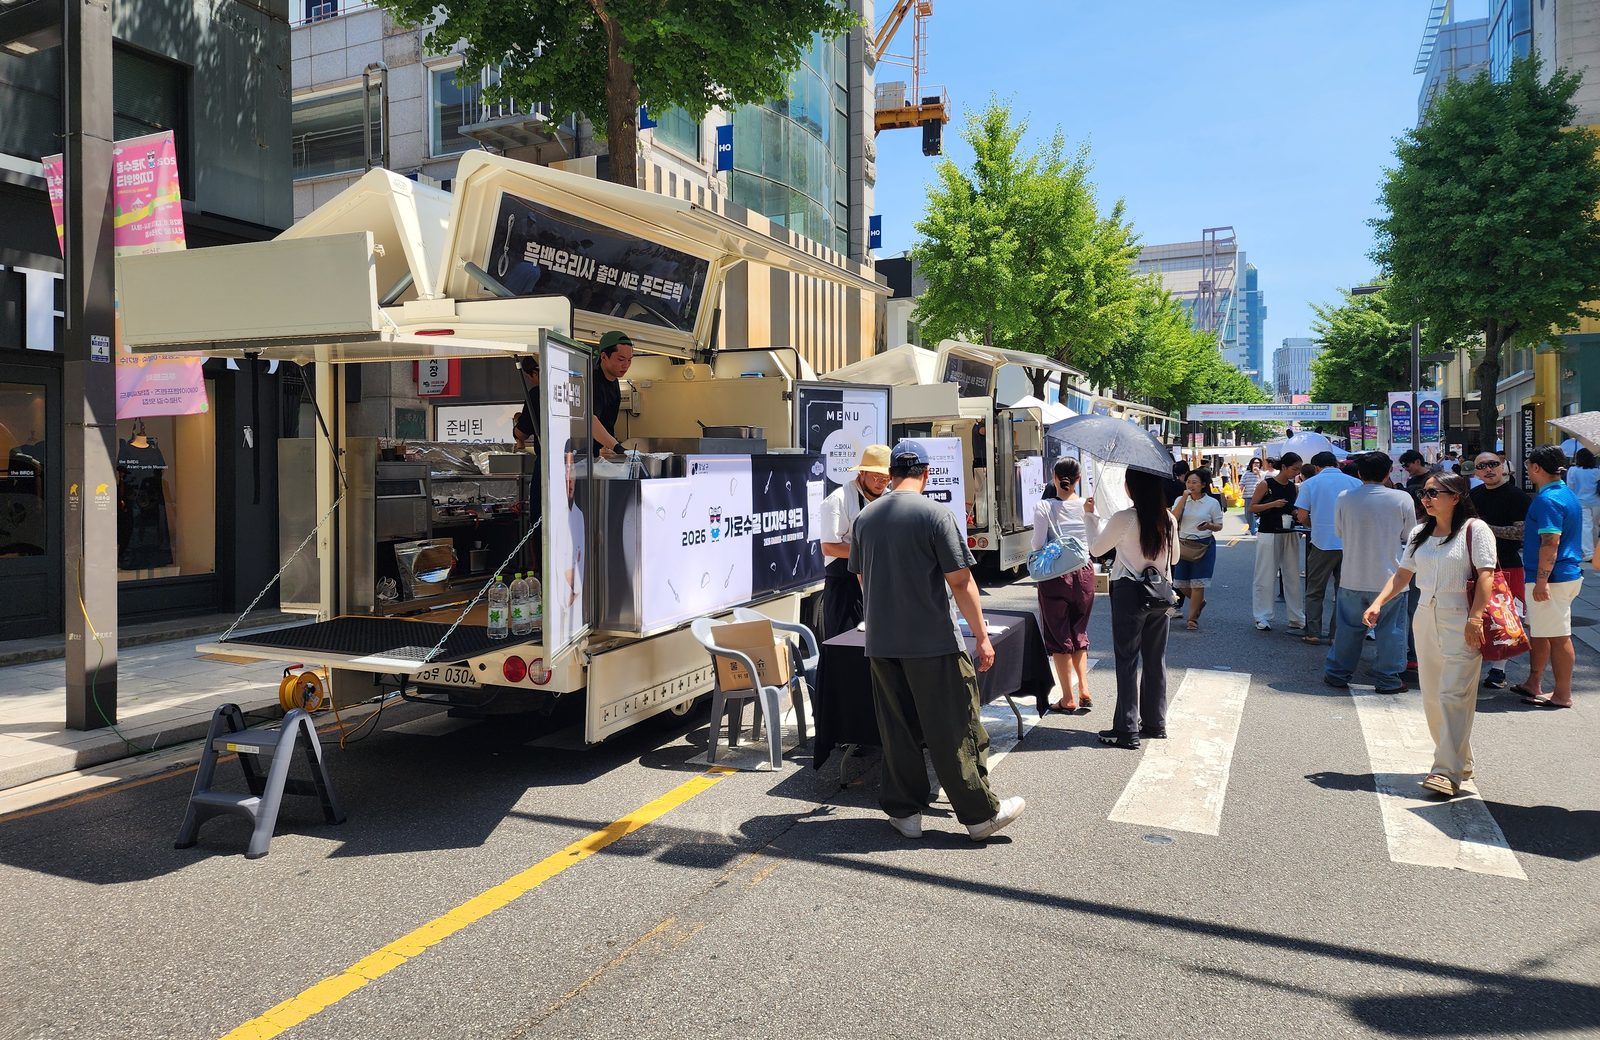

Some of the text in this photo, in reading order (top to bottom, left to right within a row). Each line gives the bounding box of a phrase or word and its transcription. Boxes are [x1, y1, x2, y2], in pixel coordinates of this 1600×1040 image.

[524, 242, 595, 280] 흑백요리사
[597, 265, 619, 285] 출연
[640, 274, 683, 303] 푸드트럭
[827, 410, 859, 421] MENU
[447, 419, 483, 436] 준비된
[1524, 409, 1534, 458] STARBUCKS
[928, 467, 949, 476] 요리사
[932, 477, 960, 486] 푸드트럭
[682, 508, 803, 546] 2026 가로수길 디자인 위크
[445, 668, 477, 685] 0304
